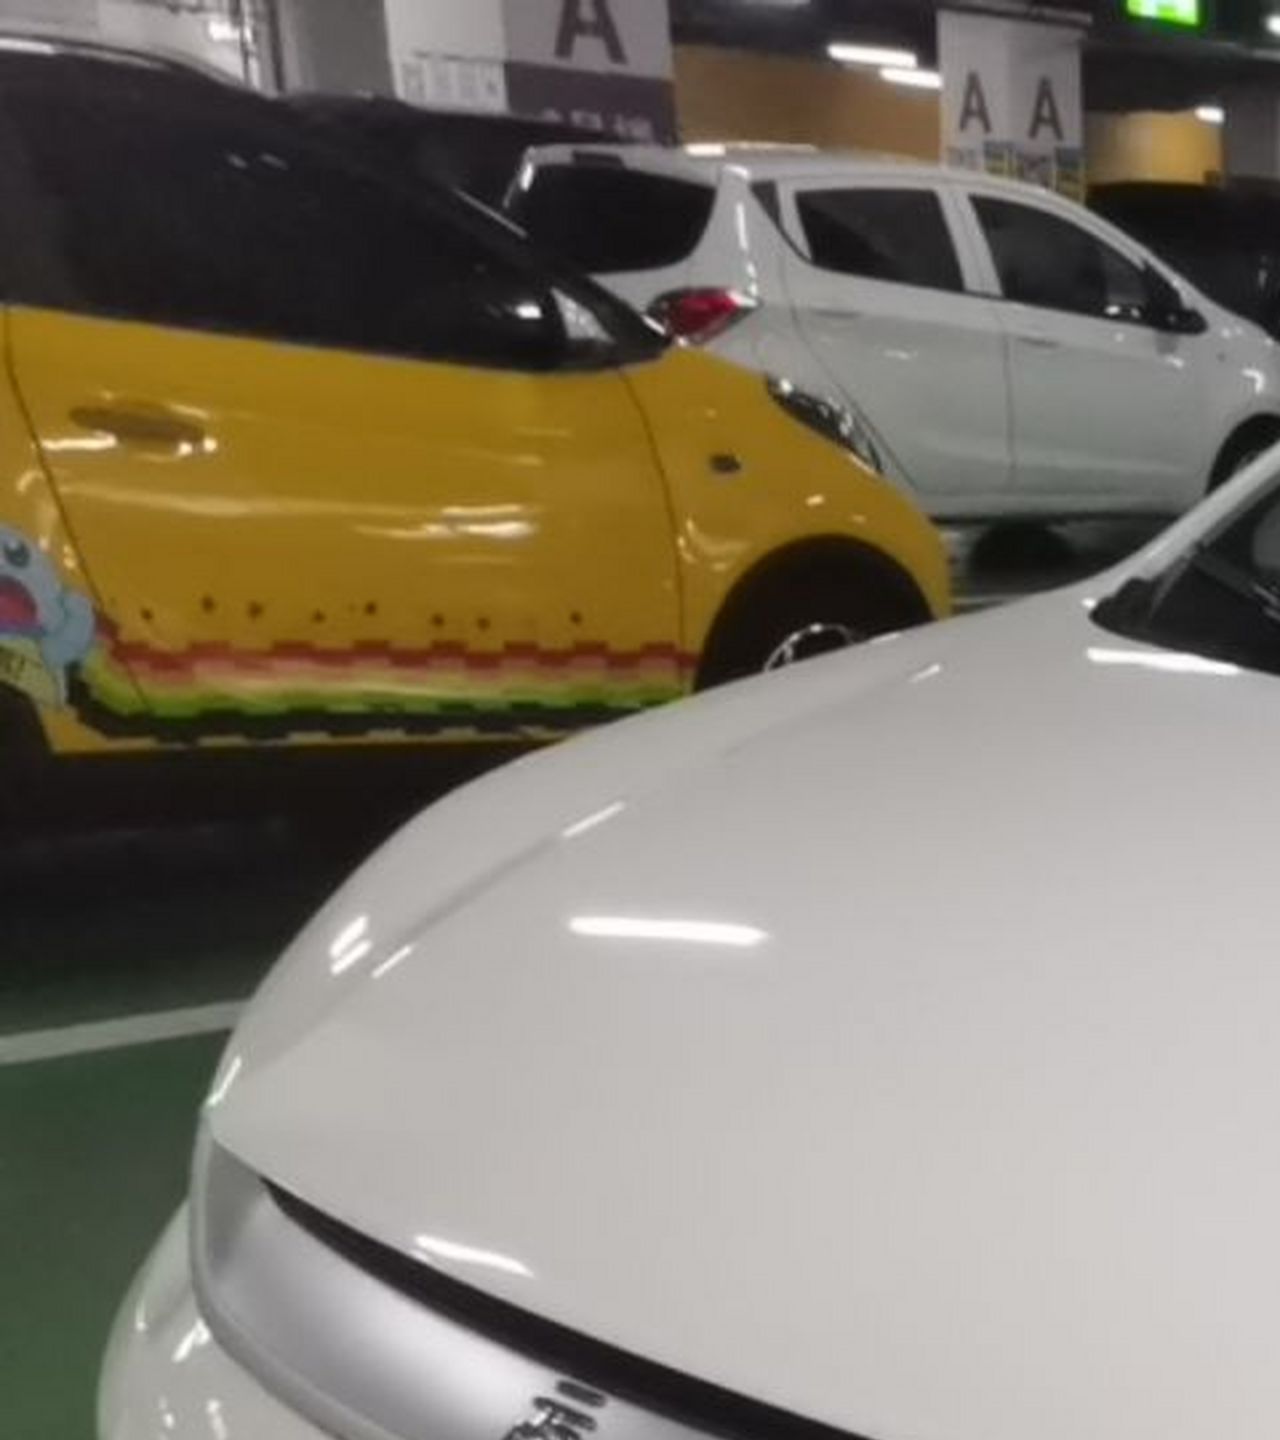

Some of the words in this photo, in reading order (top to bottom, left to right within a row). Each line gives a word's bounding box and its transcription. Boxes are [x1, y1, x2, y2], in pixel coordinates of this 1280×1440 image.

[555, 0, 627, 64] A
[959, 71, 993, 133] A
[1028, 76, 1064, 141] A
